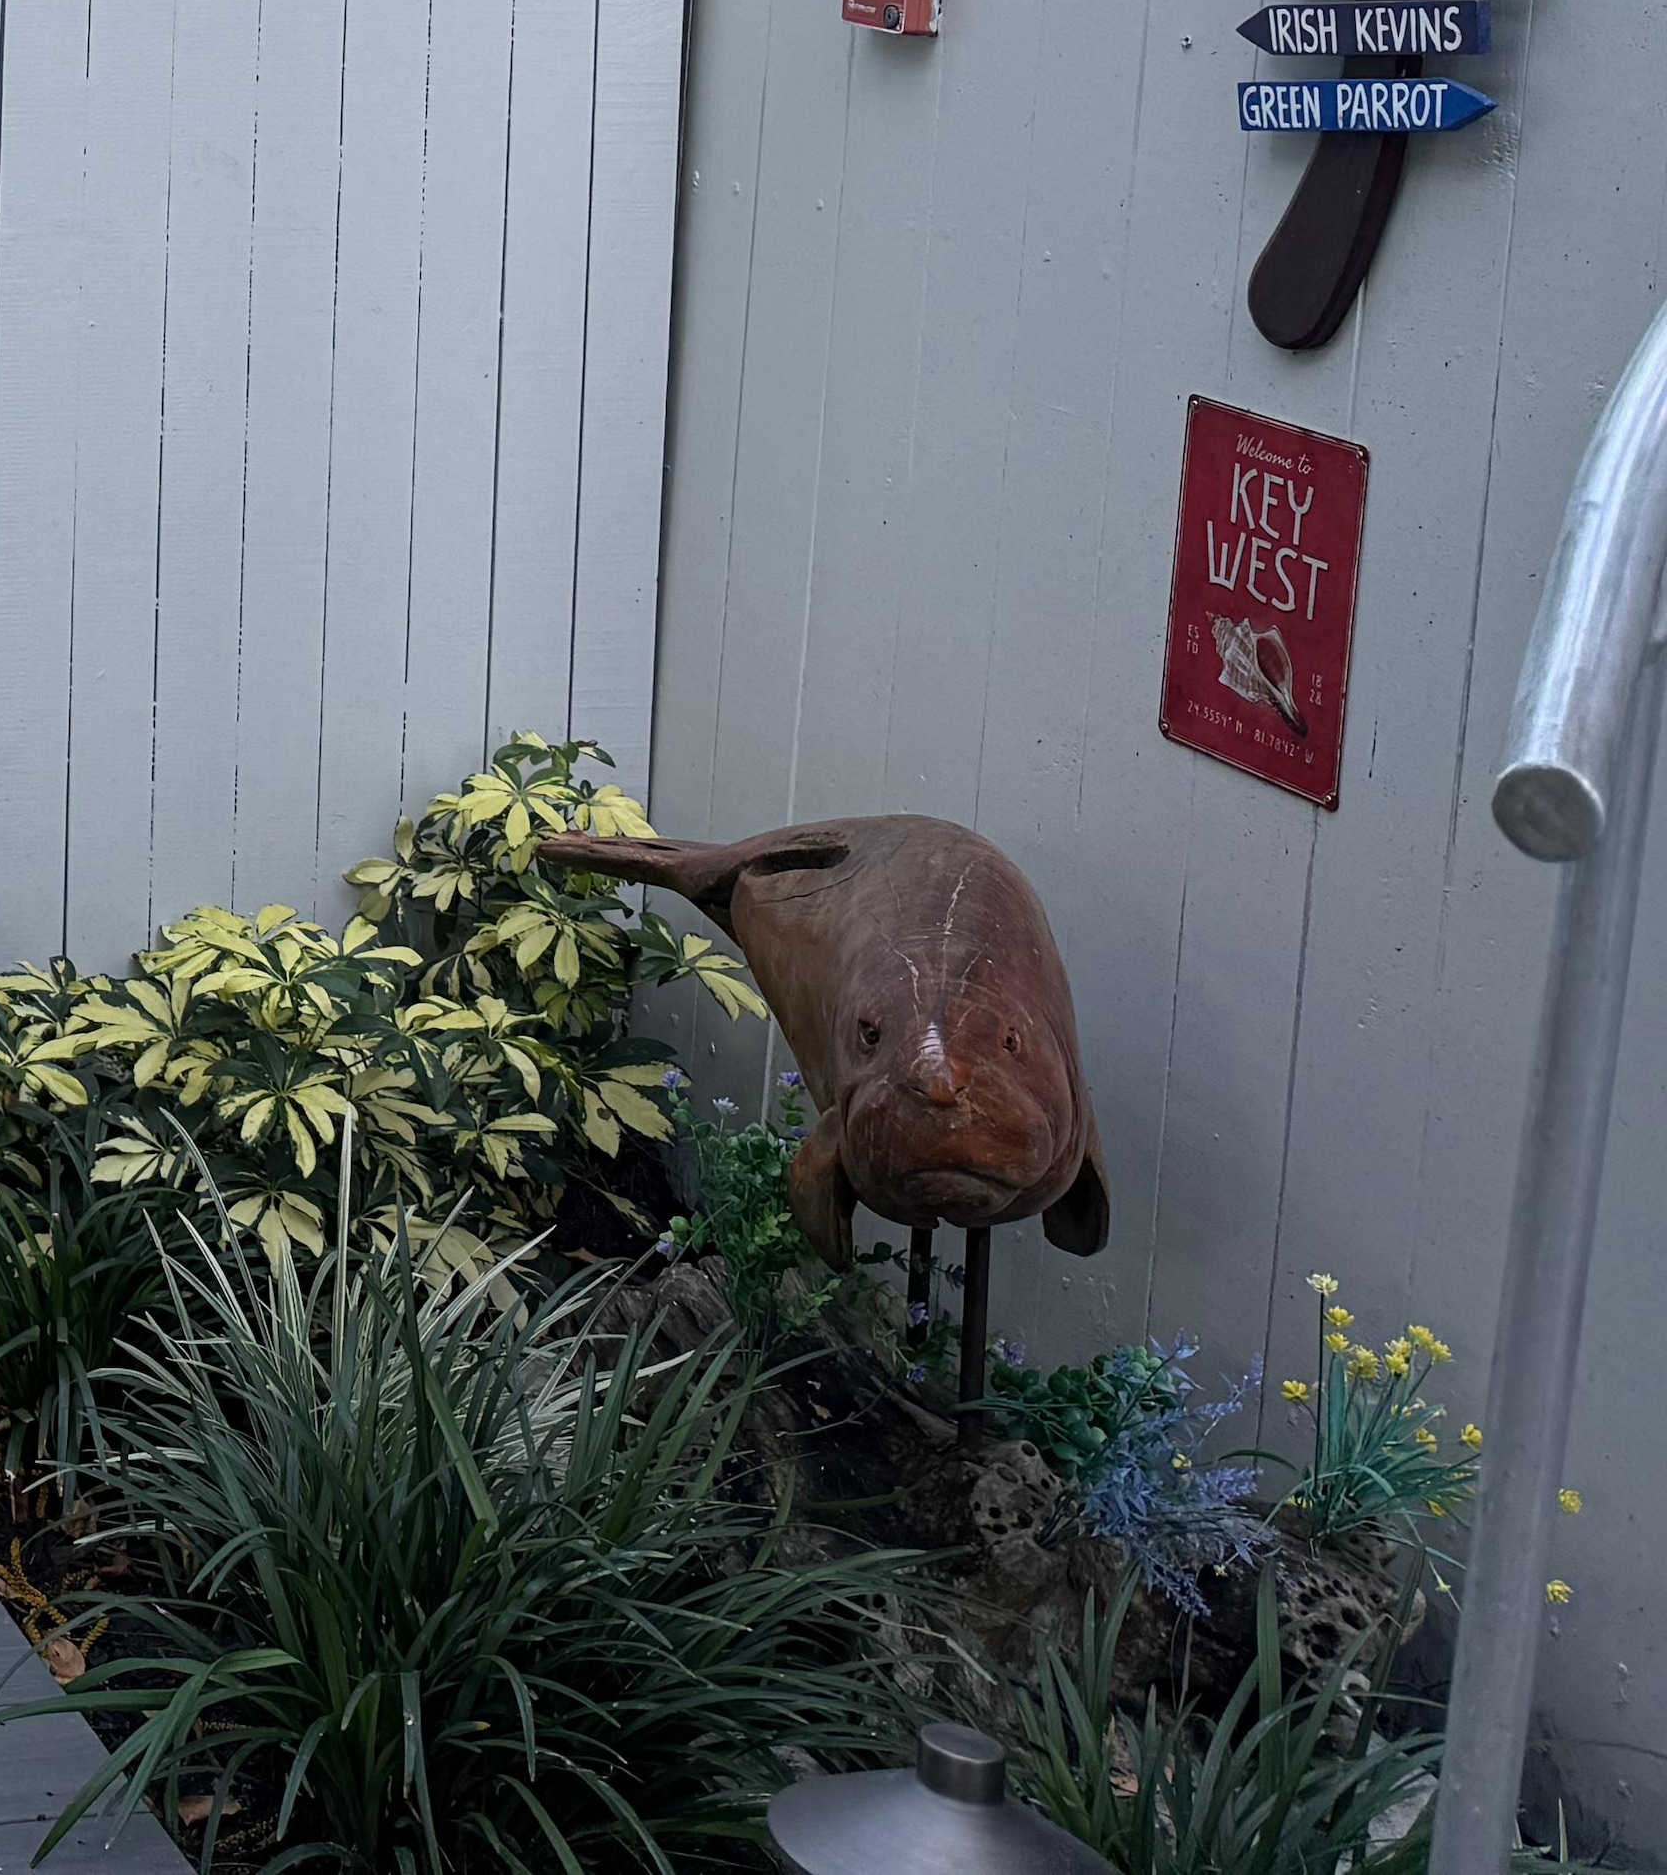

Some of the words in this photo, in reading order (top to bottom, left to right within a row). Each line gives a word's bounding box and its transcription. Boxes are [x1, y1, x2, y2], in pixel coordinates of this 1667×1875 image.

[1268, 8, 1338, 54] IRISH
[1355, 6, 1463, 53] KEVINS
[1242, 85, 1322, 128] GREEN
[1336, 83, 1449, 129] PARROT
[1236, 433, 1294, 469] Welcome
[1298, 454, 1314, 475] to
[1230, 463, 1314, 545] KEY
[1207, 520, 1329, 621] WEST
[1304, 750, 1315, 764] W
